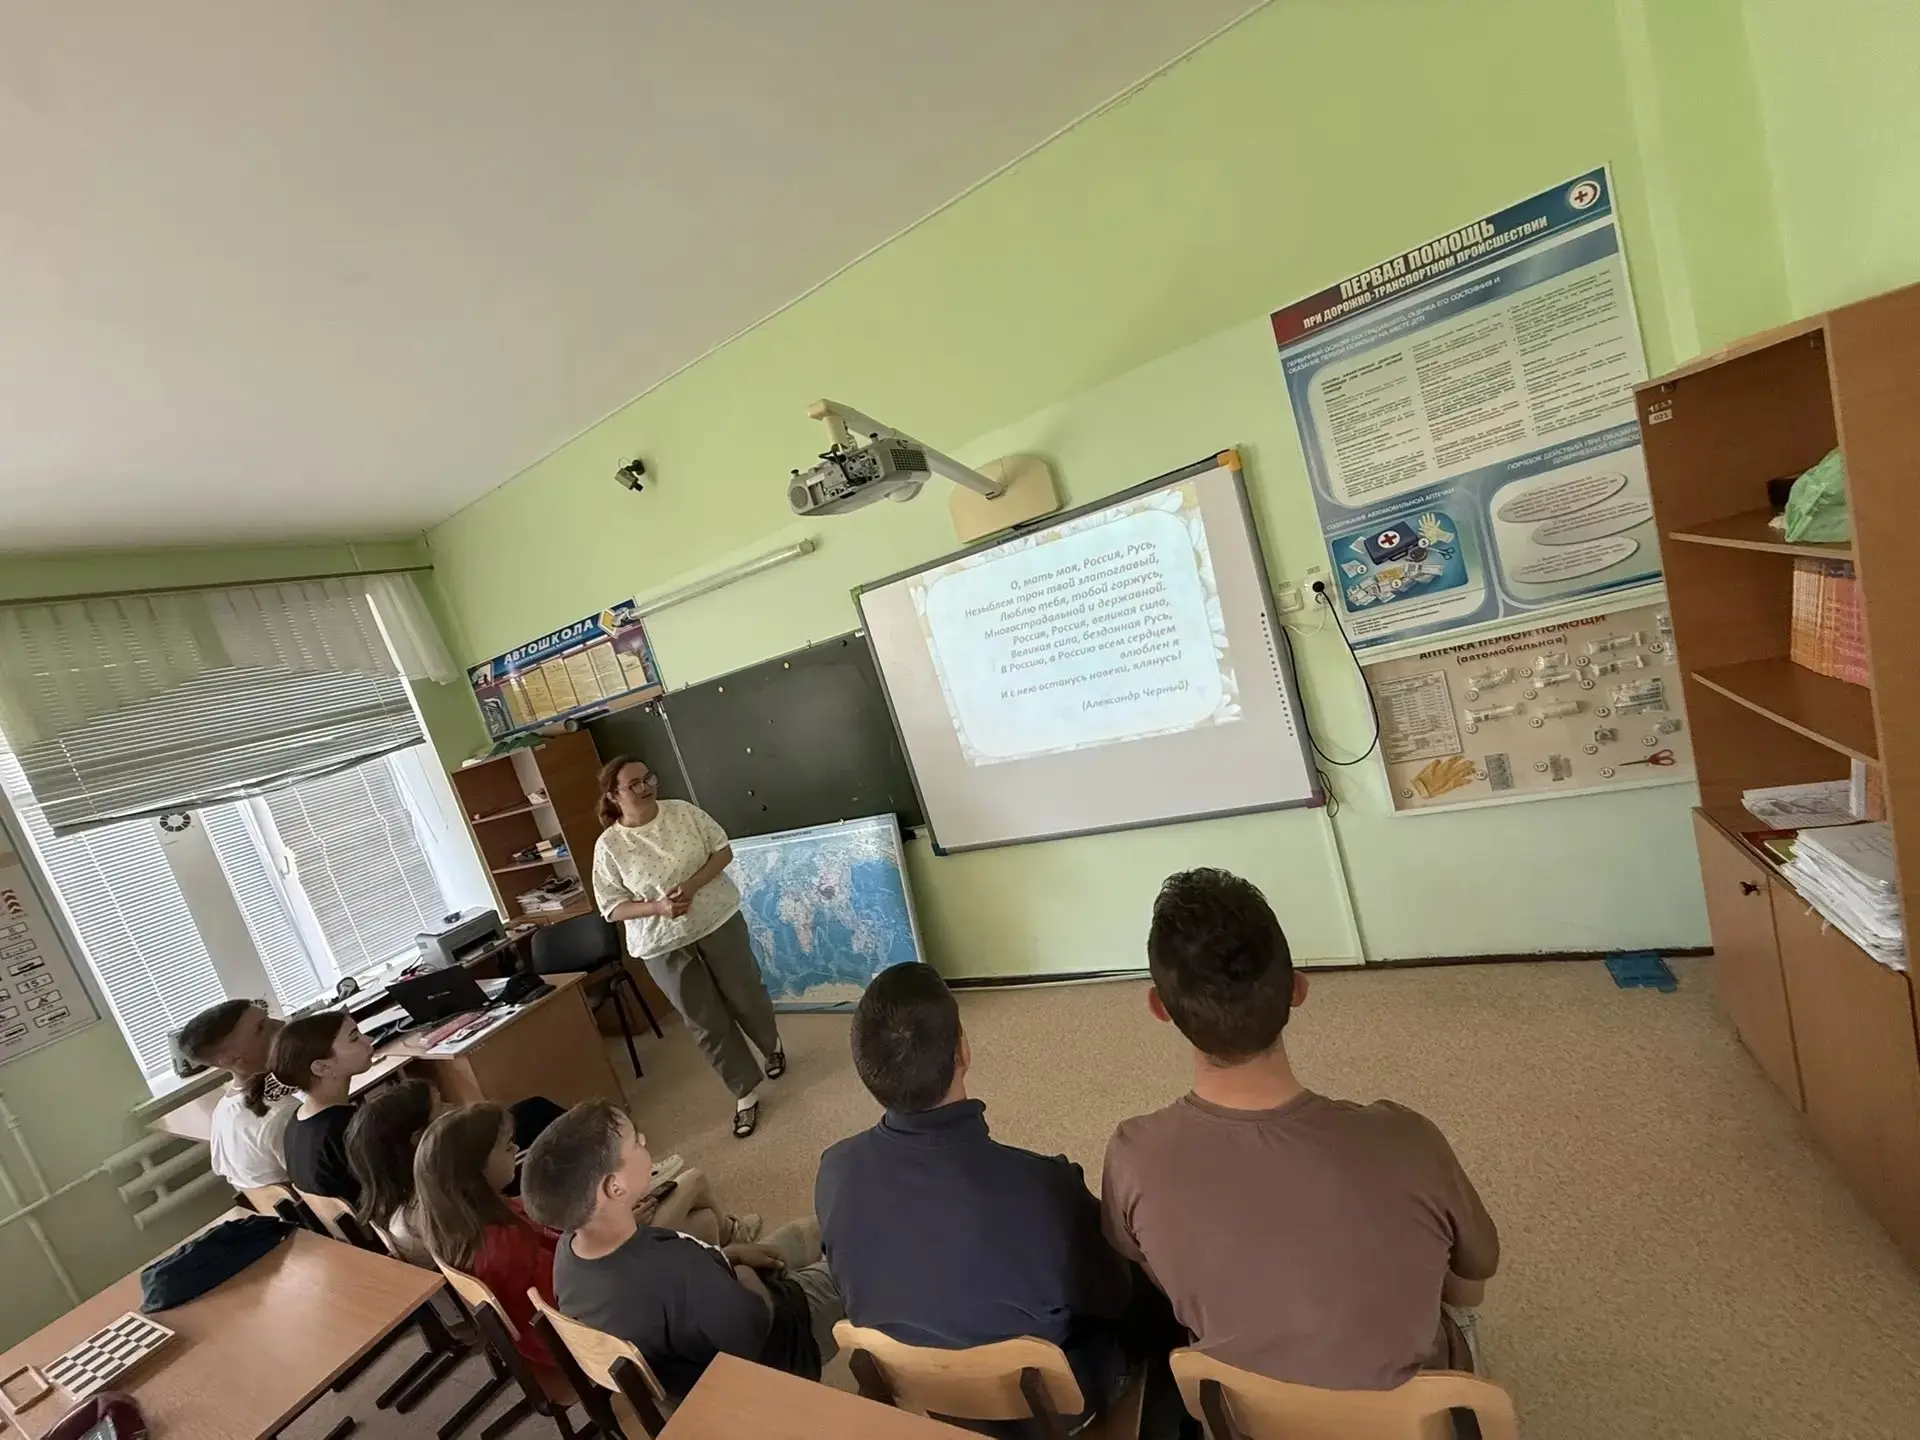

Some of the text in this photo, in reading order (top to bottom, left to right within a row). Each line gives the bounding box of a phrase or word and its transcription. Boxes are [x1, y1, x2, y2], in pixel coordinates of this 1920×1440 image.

[1302, 215, 1549, 329] ПРИ ДОРОЖНО-ТРАНСПОРТНОМ ПРОИСШЕСТВИИ
[1340, 220, 1495, 300] ПЕРВАЯ ПОМОЩЬ
[965, 552, 1160, 619] Незыблем трон твой златоглавый,
[1010, 541, 1156, 591] О, мать моя, Россия, Русь,
[984, 581, 1166, 640] Многострадальной и державной.
[999, 570, 1163, 622] Люблю тебя, тобой горжусь,
[1013, 597, 1171, 645] Россия, Россия, великая сила,
[504, 619, 594, 665] АВТОШКОЛА
[1001, 664, 1008, 675] В
[1009, 657, 1048, 673] Россию,
[1058, 645, 1096, 660] Россию
[1098, 638, 1125, 651] всем
[1127, 624, 1176, 643] сердцем
[1011, 612, 1173, 659] Великая сила, бездонная Русь,
[1120, 638, 1180, 659] влюблен я
[1419, 642, 1479, 660] АПТЕЧКА
[1535, 614, 1607, 637] ПОМОЩИ
[1456, 634, 1568, 665] (автомобильная)
[1001, 690, 1009, 700] И
[1017, 684, 1037, 697] нею
[1039, 672, 1088, 692] останусь
[1089, 664, 1131, 681] навеки,
[1133, 649, 1182, 671] клянусь!
[1082, 679, 1189, 712] (Александр Черный)
